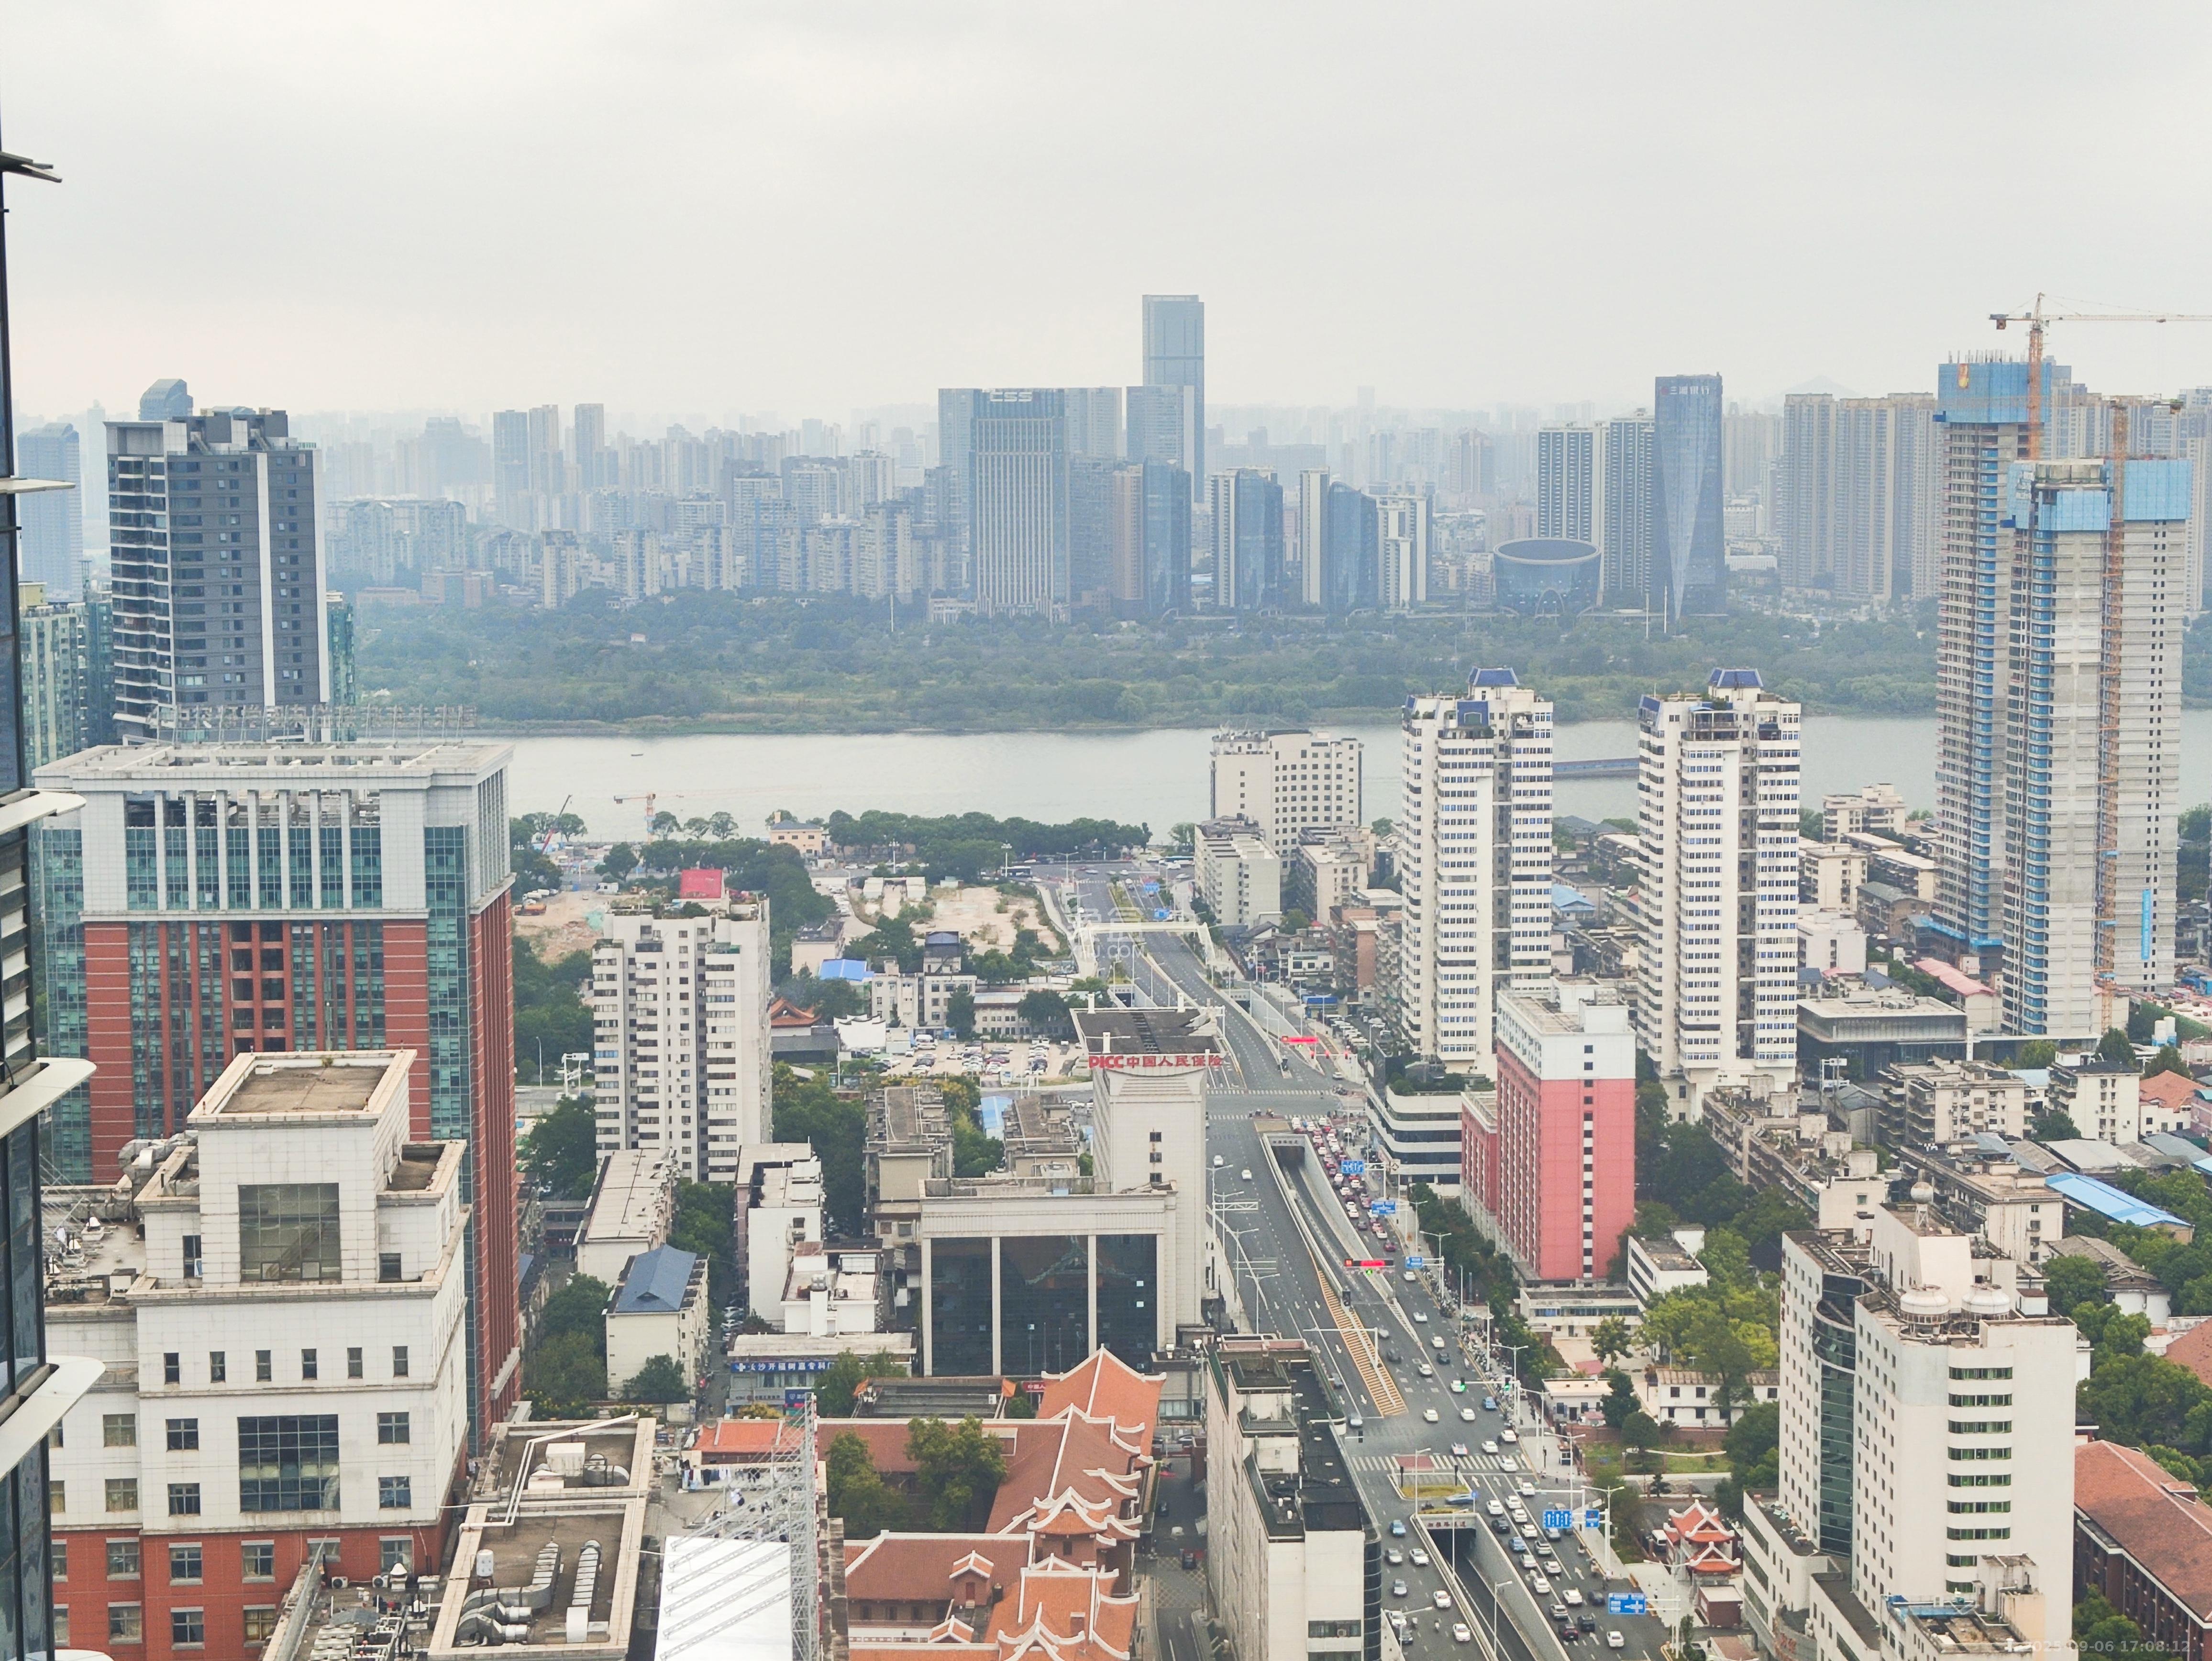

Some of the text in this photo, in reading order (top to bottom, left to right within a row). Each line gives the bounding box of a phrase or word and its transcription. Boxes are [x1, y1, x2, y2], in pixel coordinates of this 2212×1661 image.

[1089, 1055, 1223, 1069] PICC 中国人民保险
